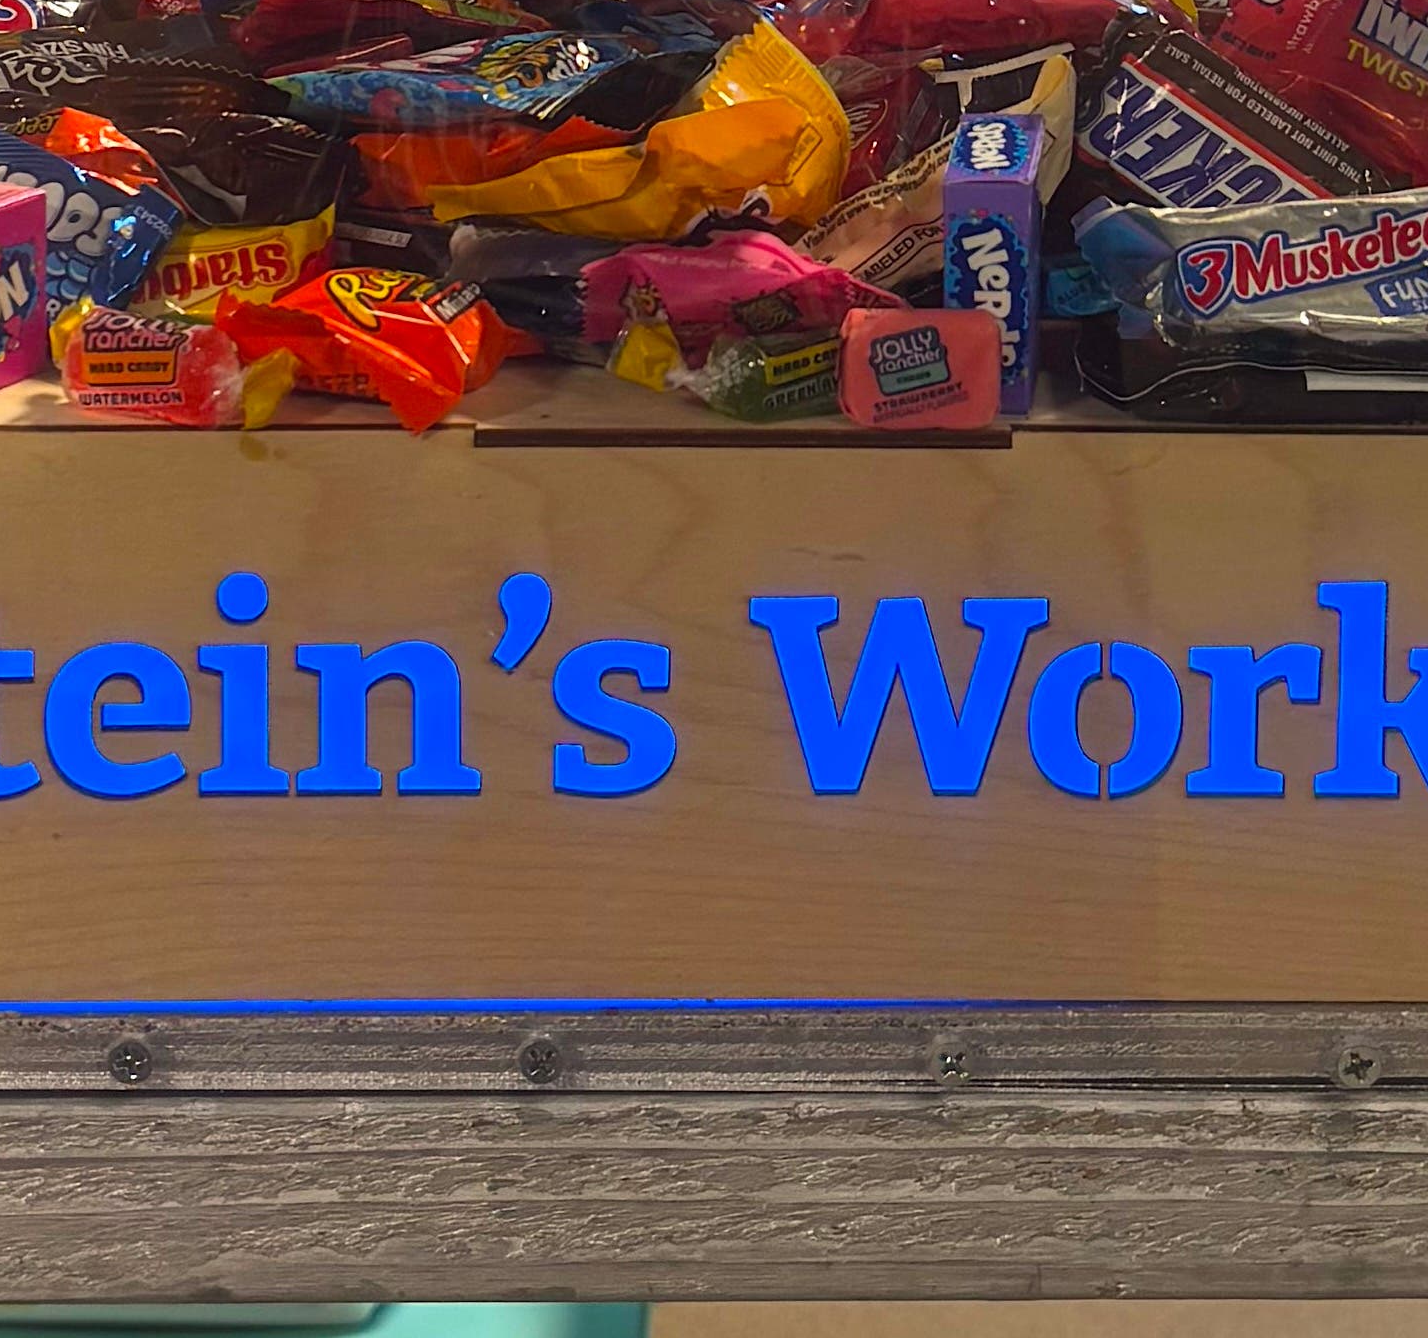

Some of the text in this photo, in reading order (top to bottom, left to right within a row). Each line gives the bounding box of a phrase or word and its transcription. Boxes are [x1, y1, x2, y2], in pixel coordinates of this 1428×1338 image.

[1163, 42, 1192, 66] SALE
[1189, 58, 1226, 88] RETAIL
[1223, 82, 1248, 103] FOR
[1244, 96, 1293, 135] LABELED
[1337, 160, 1363, 182] THIS
[861, 235, 918, 281] ABELED
[1186, 250, 1227, 309] 3
[874, 331, 933, 364] JOLLY
[879, 348, 943, 374] rancher
[79, 390, 183, 407] WATERMELON
